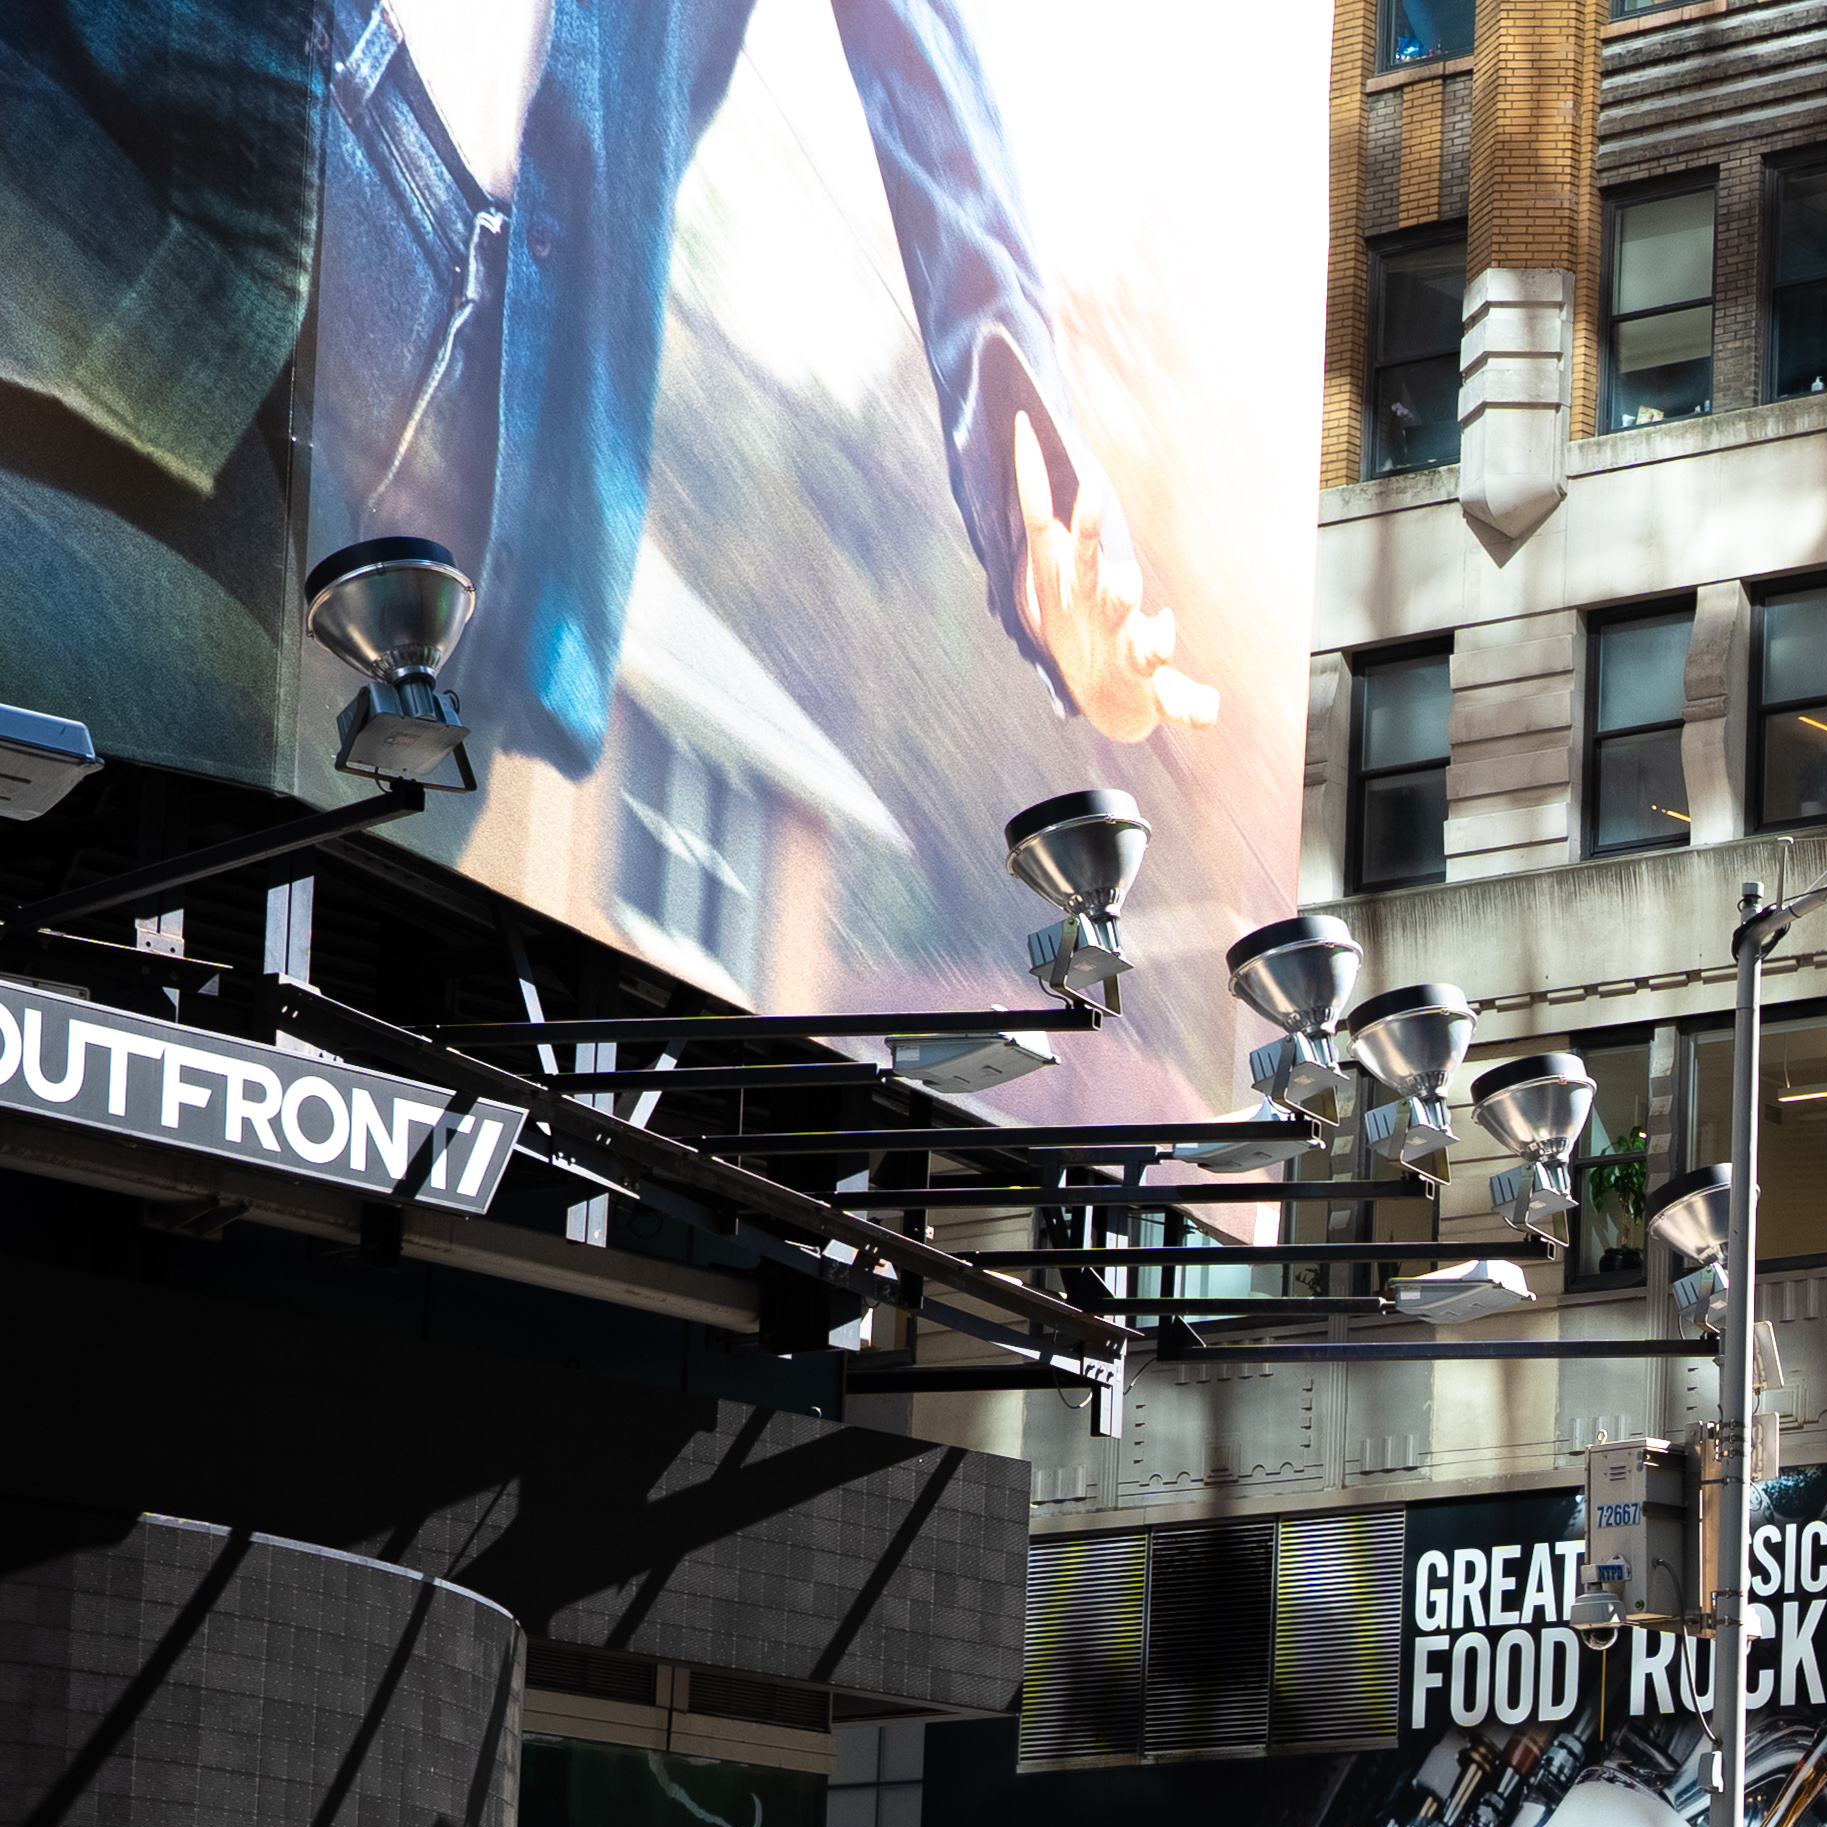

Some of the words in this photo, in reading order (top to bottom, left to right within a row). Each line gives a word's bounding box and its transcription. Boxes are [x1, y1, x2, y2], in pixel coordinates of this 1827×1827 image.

[1413, 1539, 1586, 1632] GREAT
[1598, 1565, 1623, 1581] NYPD
[1411, 1627, 1580, 1730] FOOD
